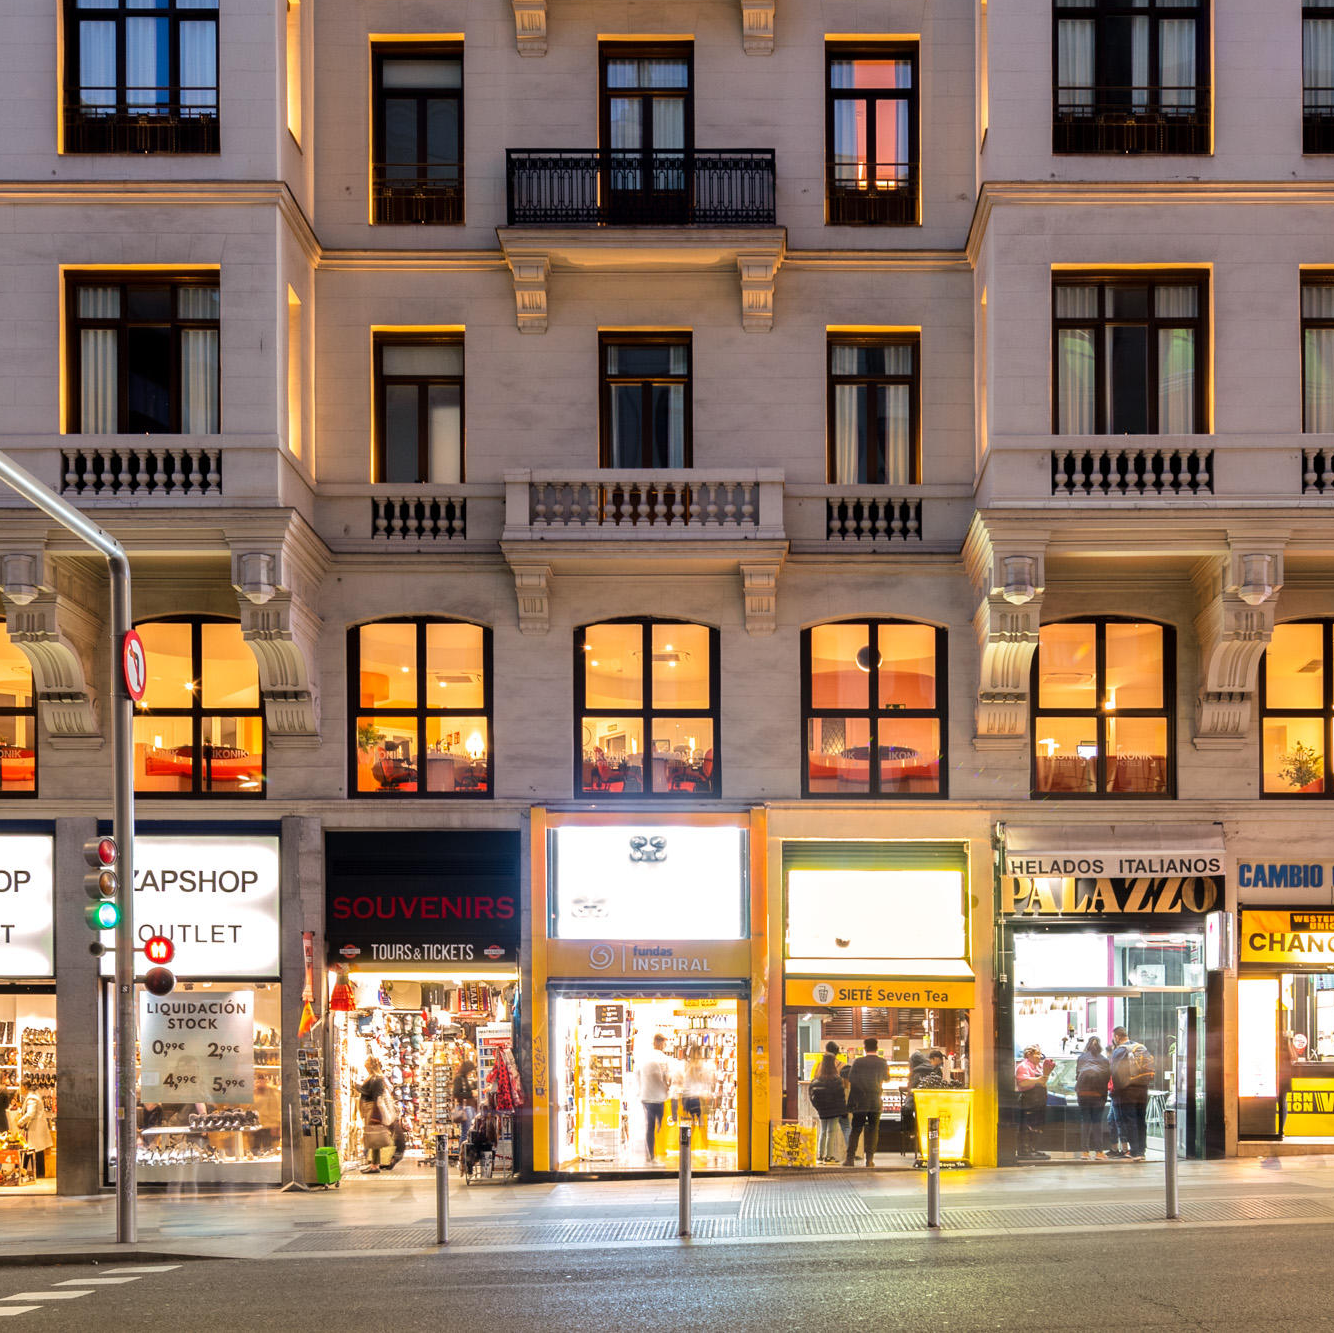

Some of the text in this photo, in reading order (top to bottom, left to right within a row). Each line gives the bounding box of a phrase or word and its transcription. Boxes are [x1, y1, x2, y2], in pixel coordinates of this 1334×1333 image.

[1011, 858, 1221, 874] HELADOS ITALIANOS
[1238, 864, 1324, 888] CAMBIO
[1000, 875, 1218, 913] PALAZZO
[333, 896, 515, 920] SOUVENIRS
[138, 924, 242, 943] OUTLET
[371, 944, 412, 960] TOURS
[422, 944, 474, 960] TICKETS
[633, 945, 673, 957] fundas
[633, 958, 711, 971] INSPIRAL
[839, 985, 949, 1003] SIETÉ Seven Tea
[147, 1000, 246, 1016] LIQUIDACIÓN
[167, 1018, 218, 1030] STOCK
[152, 1040, 239, 1060] 0,99€ 2,99€
[162, 1073, 245, 1093] 4,99€ 5,99€
[1286, 1102, 1313, 1112] ION
